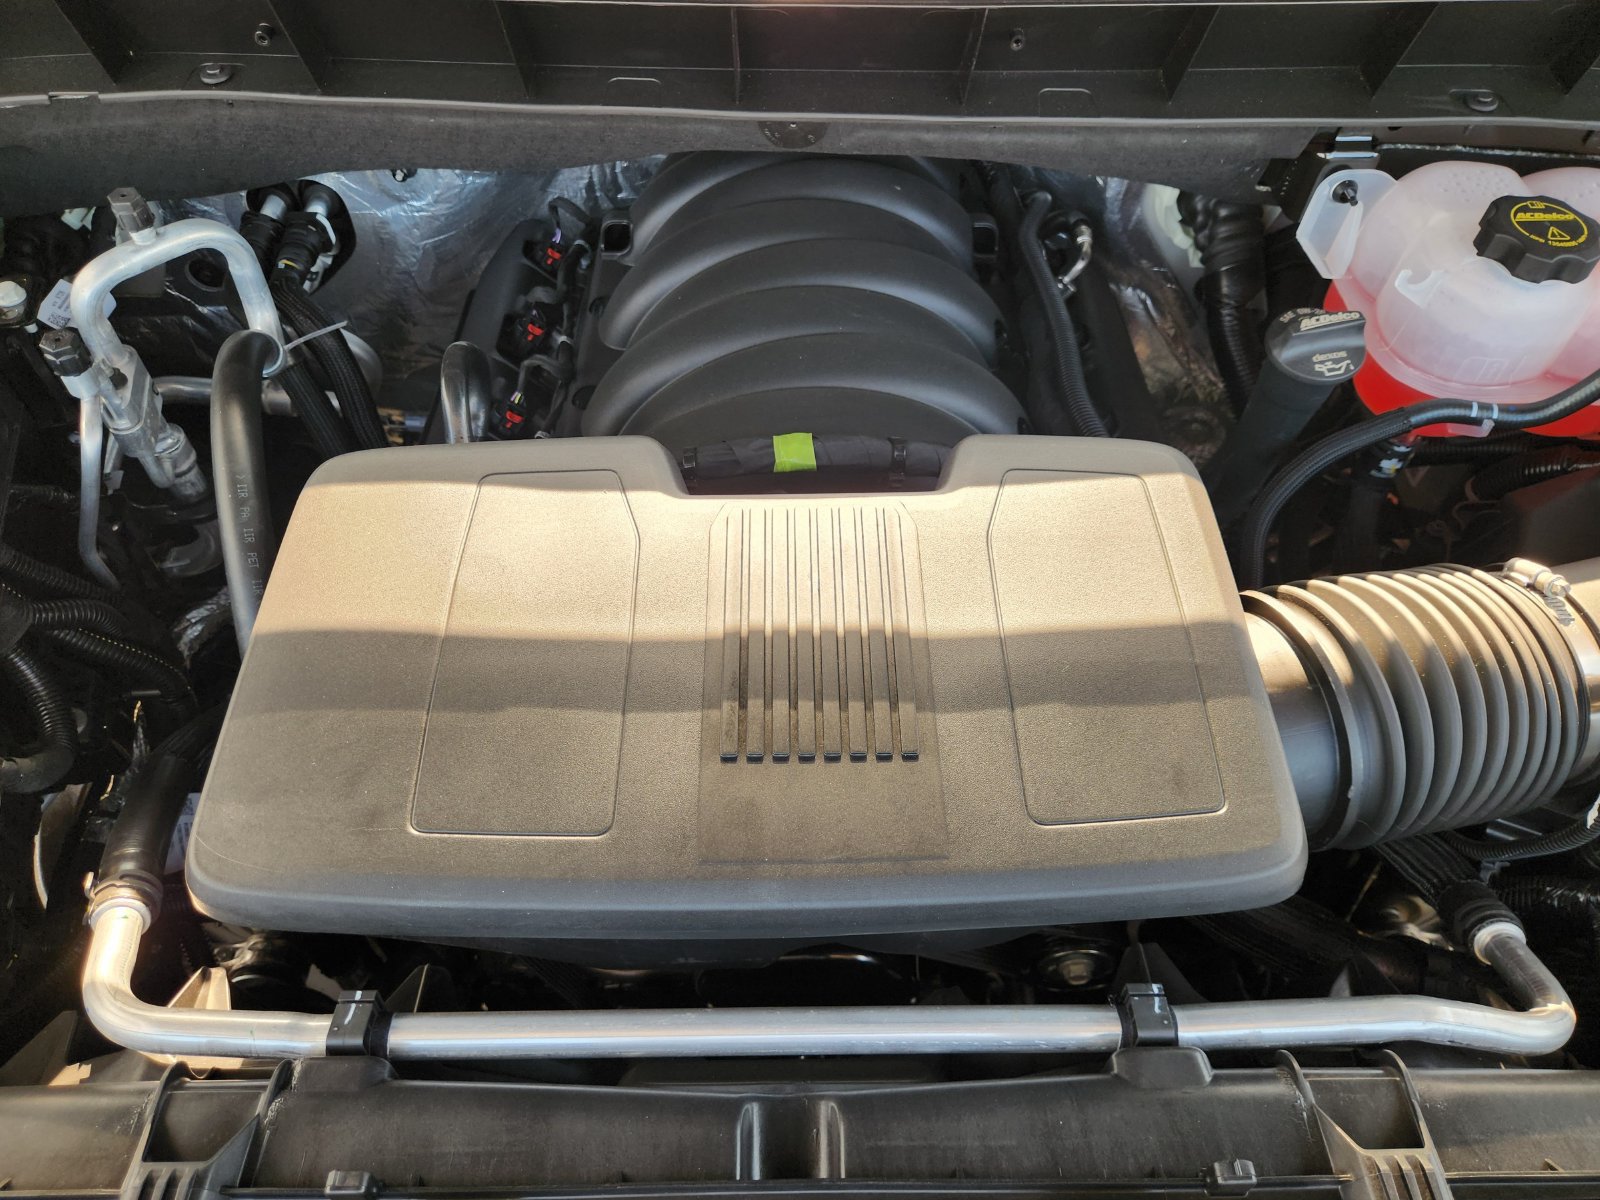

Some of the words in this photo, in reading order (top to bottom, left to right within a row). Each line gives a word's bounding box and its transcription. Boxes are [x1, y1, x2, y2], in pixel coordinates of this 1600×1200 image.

[1515, 213, 1574, 222] ACDelco
[1279, 311, 1295, 323] SAE
[1300, 311, 1360, 331] ACDelco
[1312, 352, 1347, 362] dexos
[247, 552, 260, 568] PET
